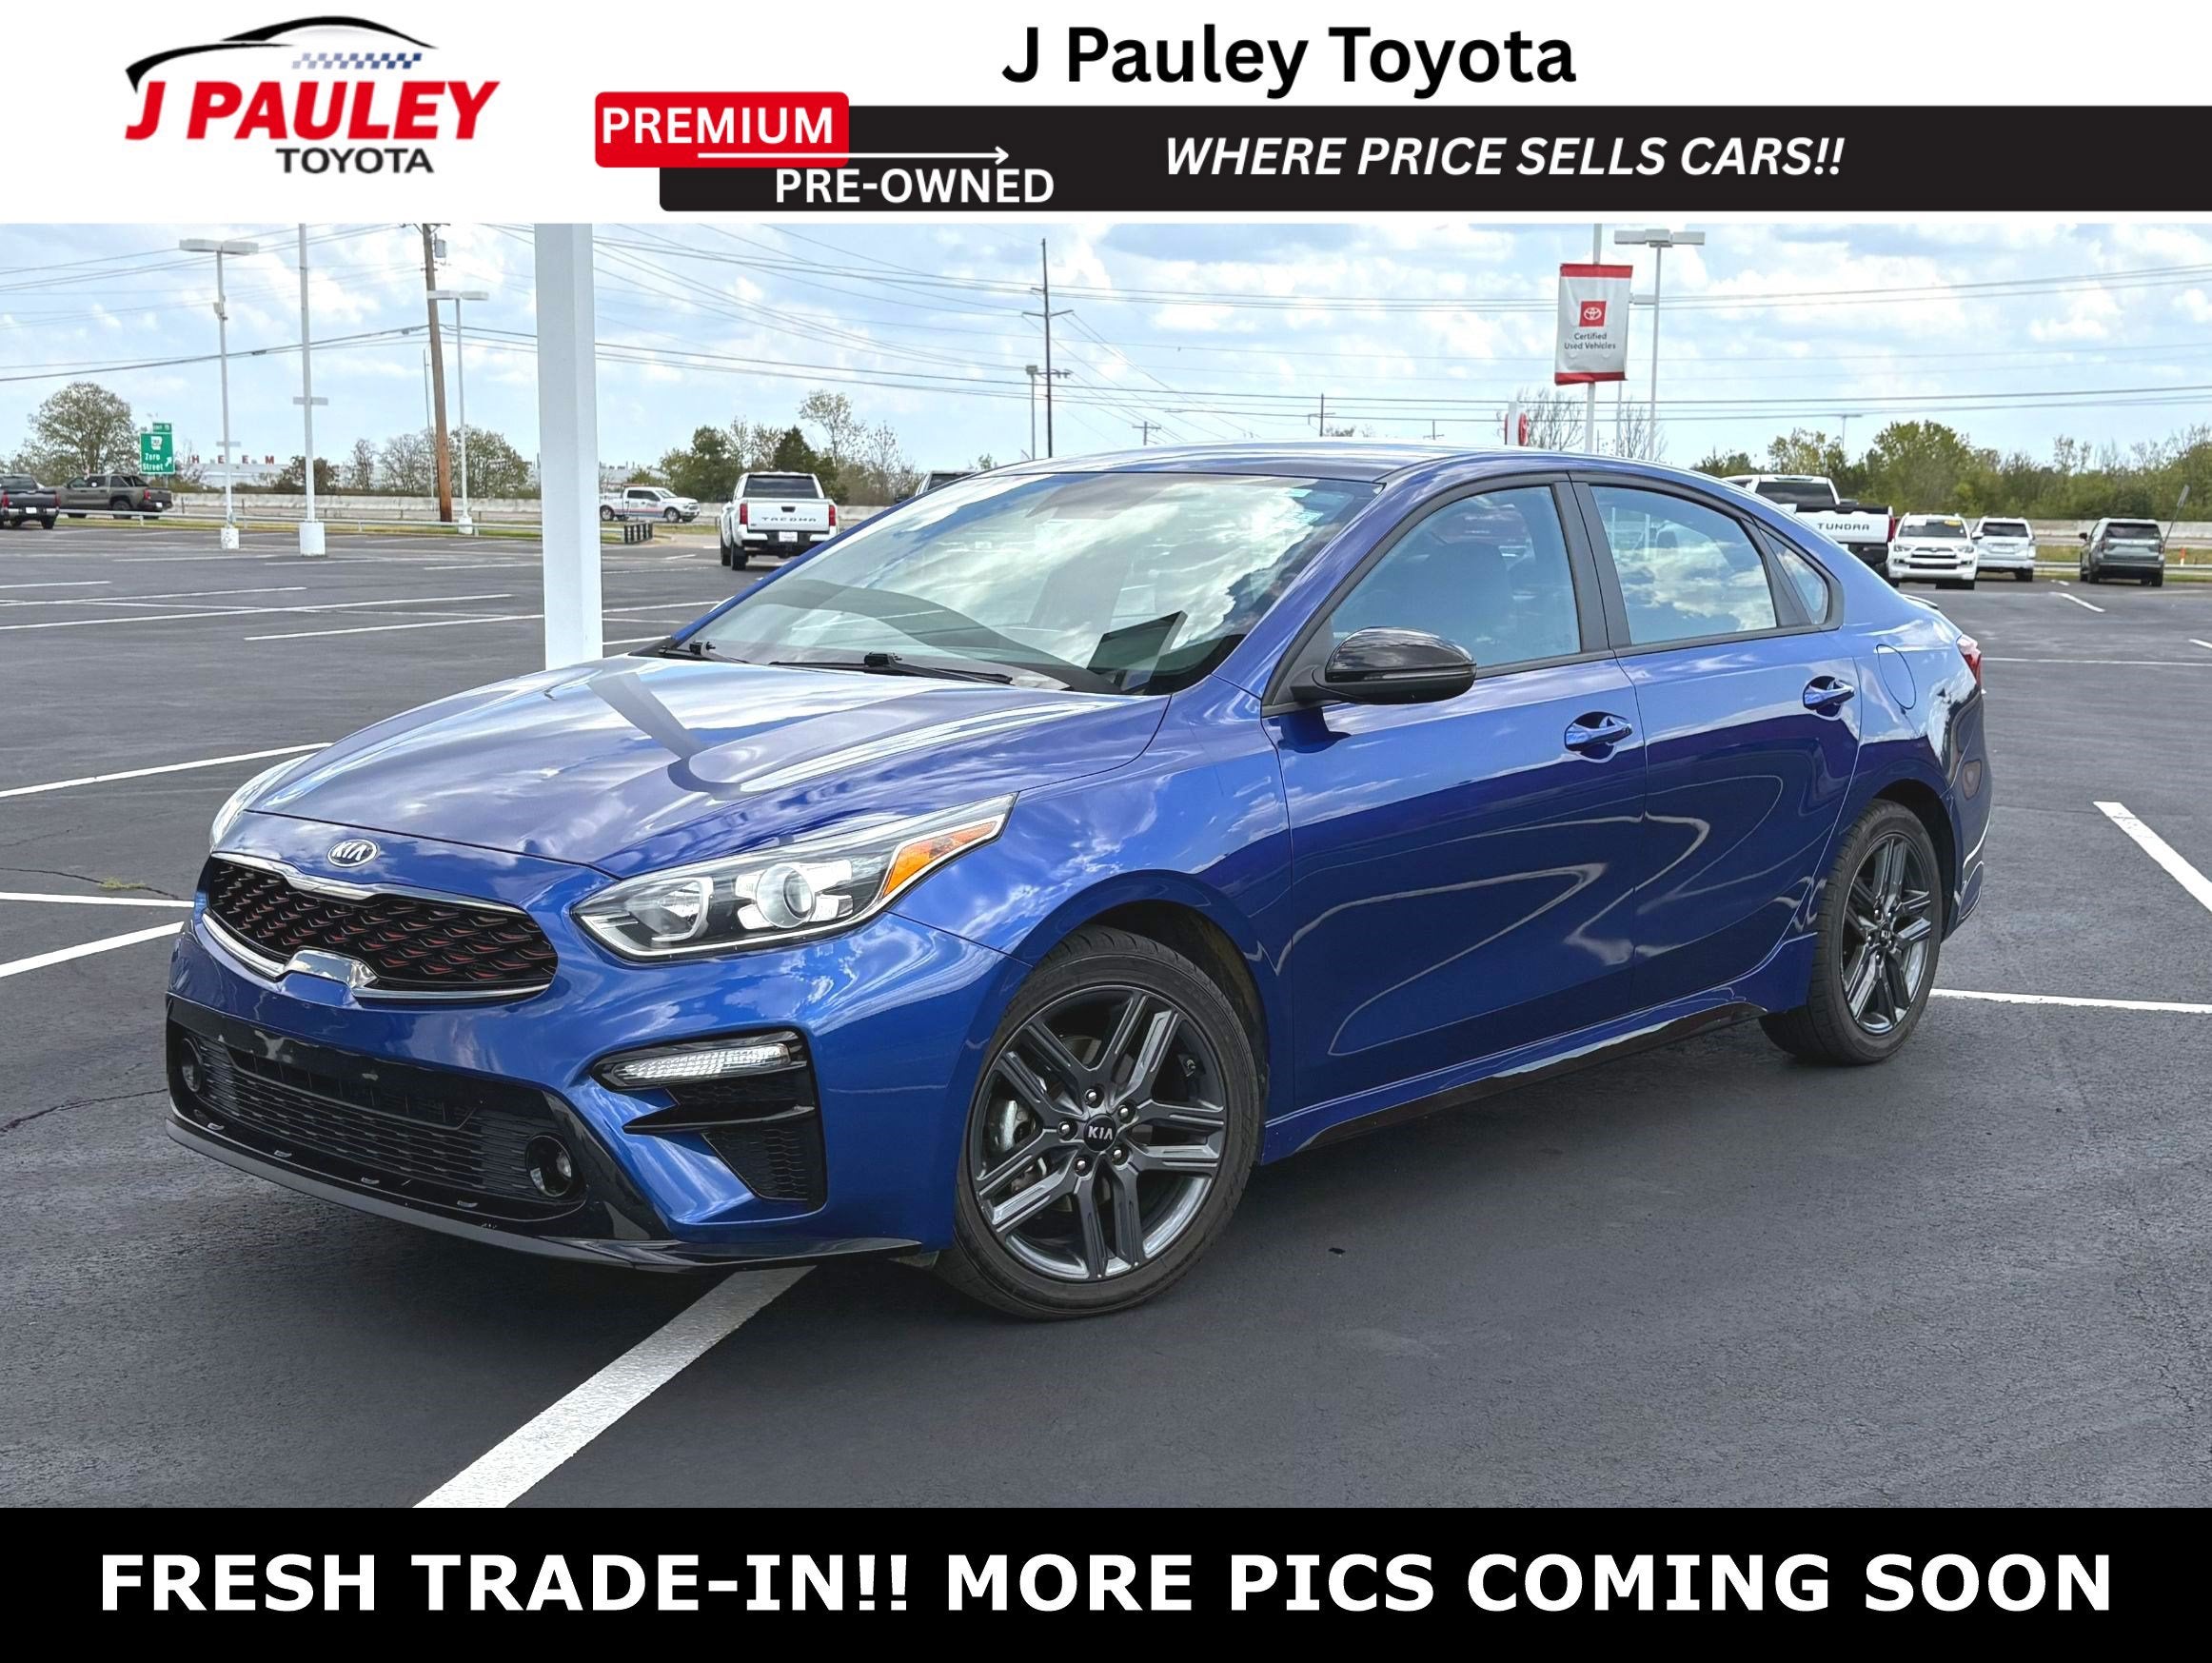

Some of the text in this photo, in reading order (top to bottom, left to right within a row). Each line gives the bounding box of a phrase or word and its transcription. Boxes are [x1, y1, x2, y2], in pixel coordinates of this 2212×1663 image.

[145, 452, 161, 461] Zero
[142, 463, 164, 471] Street
[1817, 523, 1870, 531] TUNDRA
[331, 841, 367, 861] KIA
[1088, 1125, 1113, 1140] KIA
